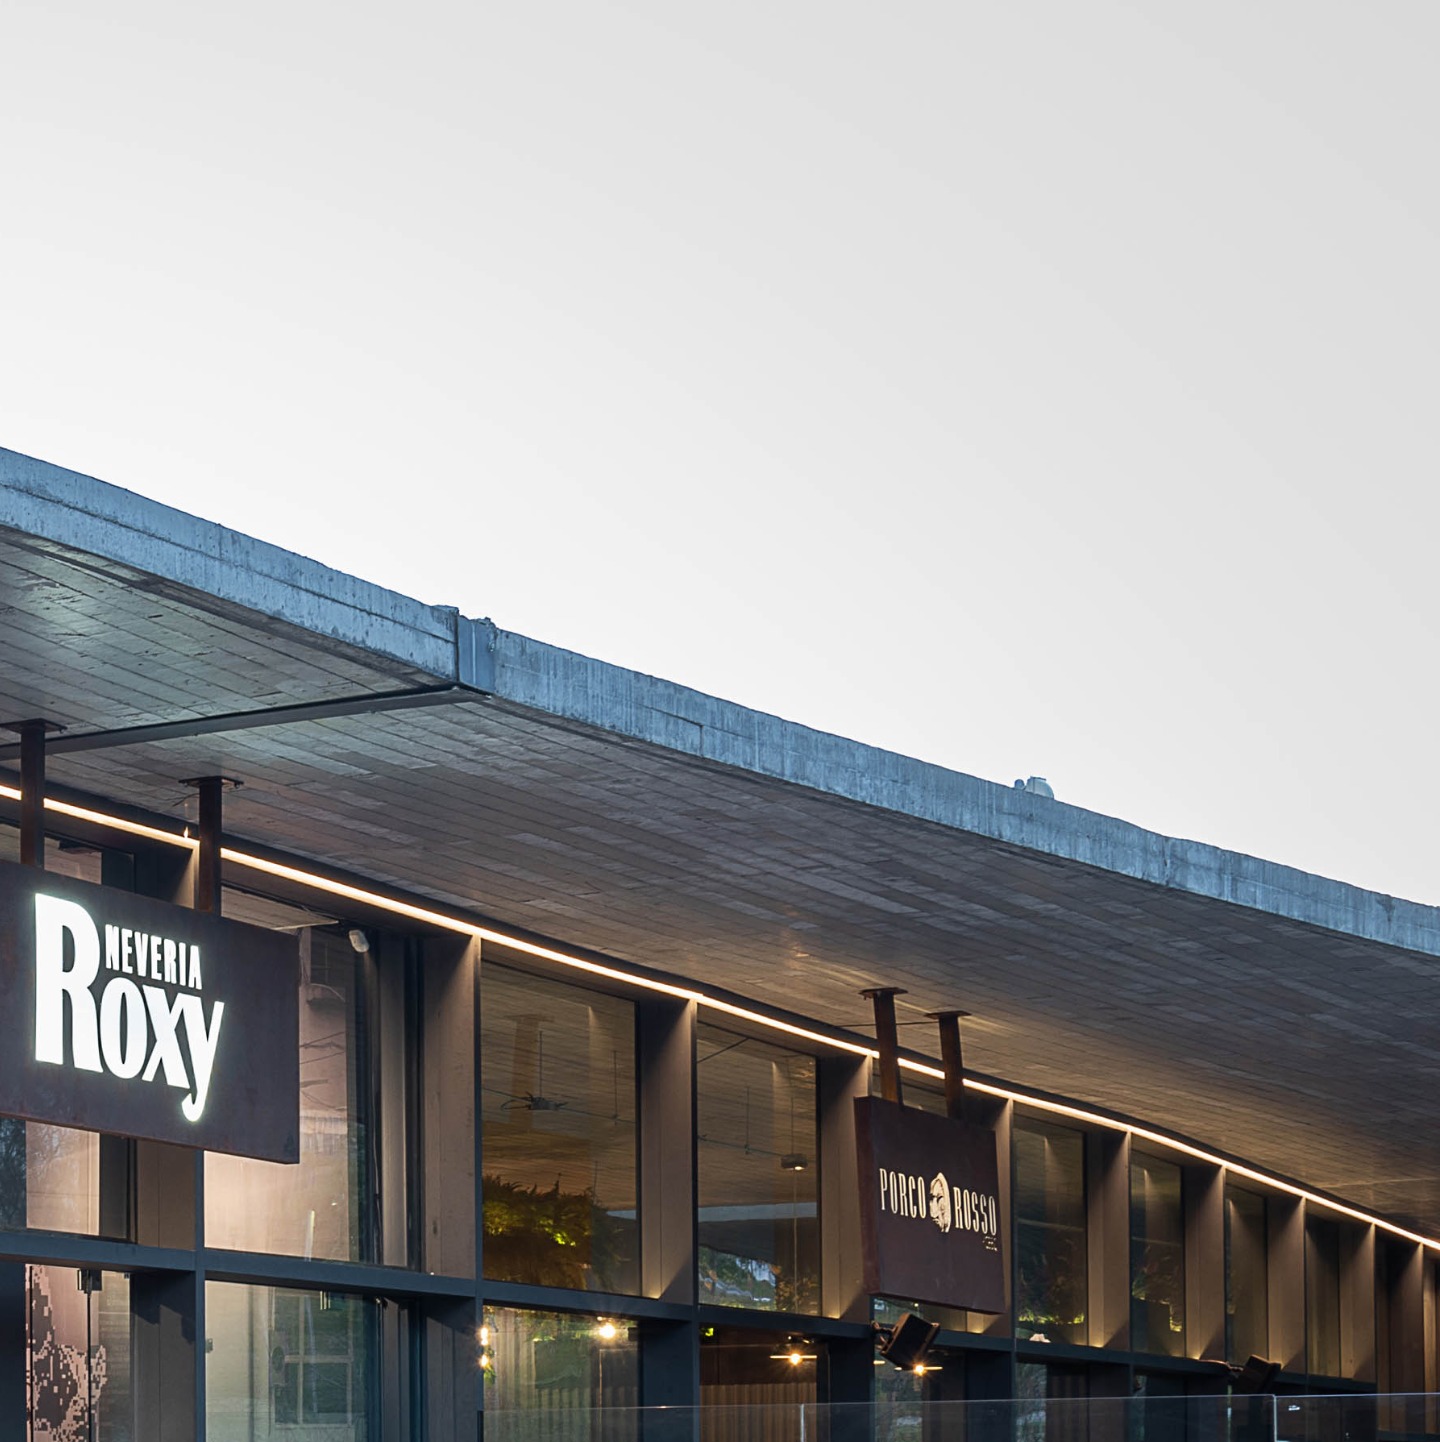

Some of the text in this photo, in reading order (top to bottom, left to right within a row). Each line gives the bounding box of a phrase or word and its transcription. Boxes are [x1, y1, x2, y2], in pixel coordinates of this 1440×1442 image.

[105, 924, 202, 990] NEVERIA
[880, 1168, 997, 1236] PORCO ROSSO
